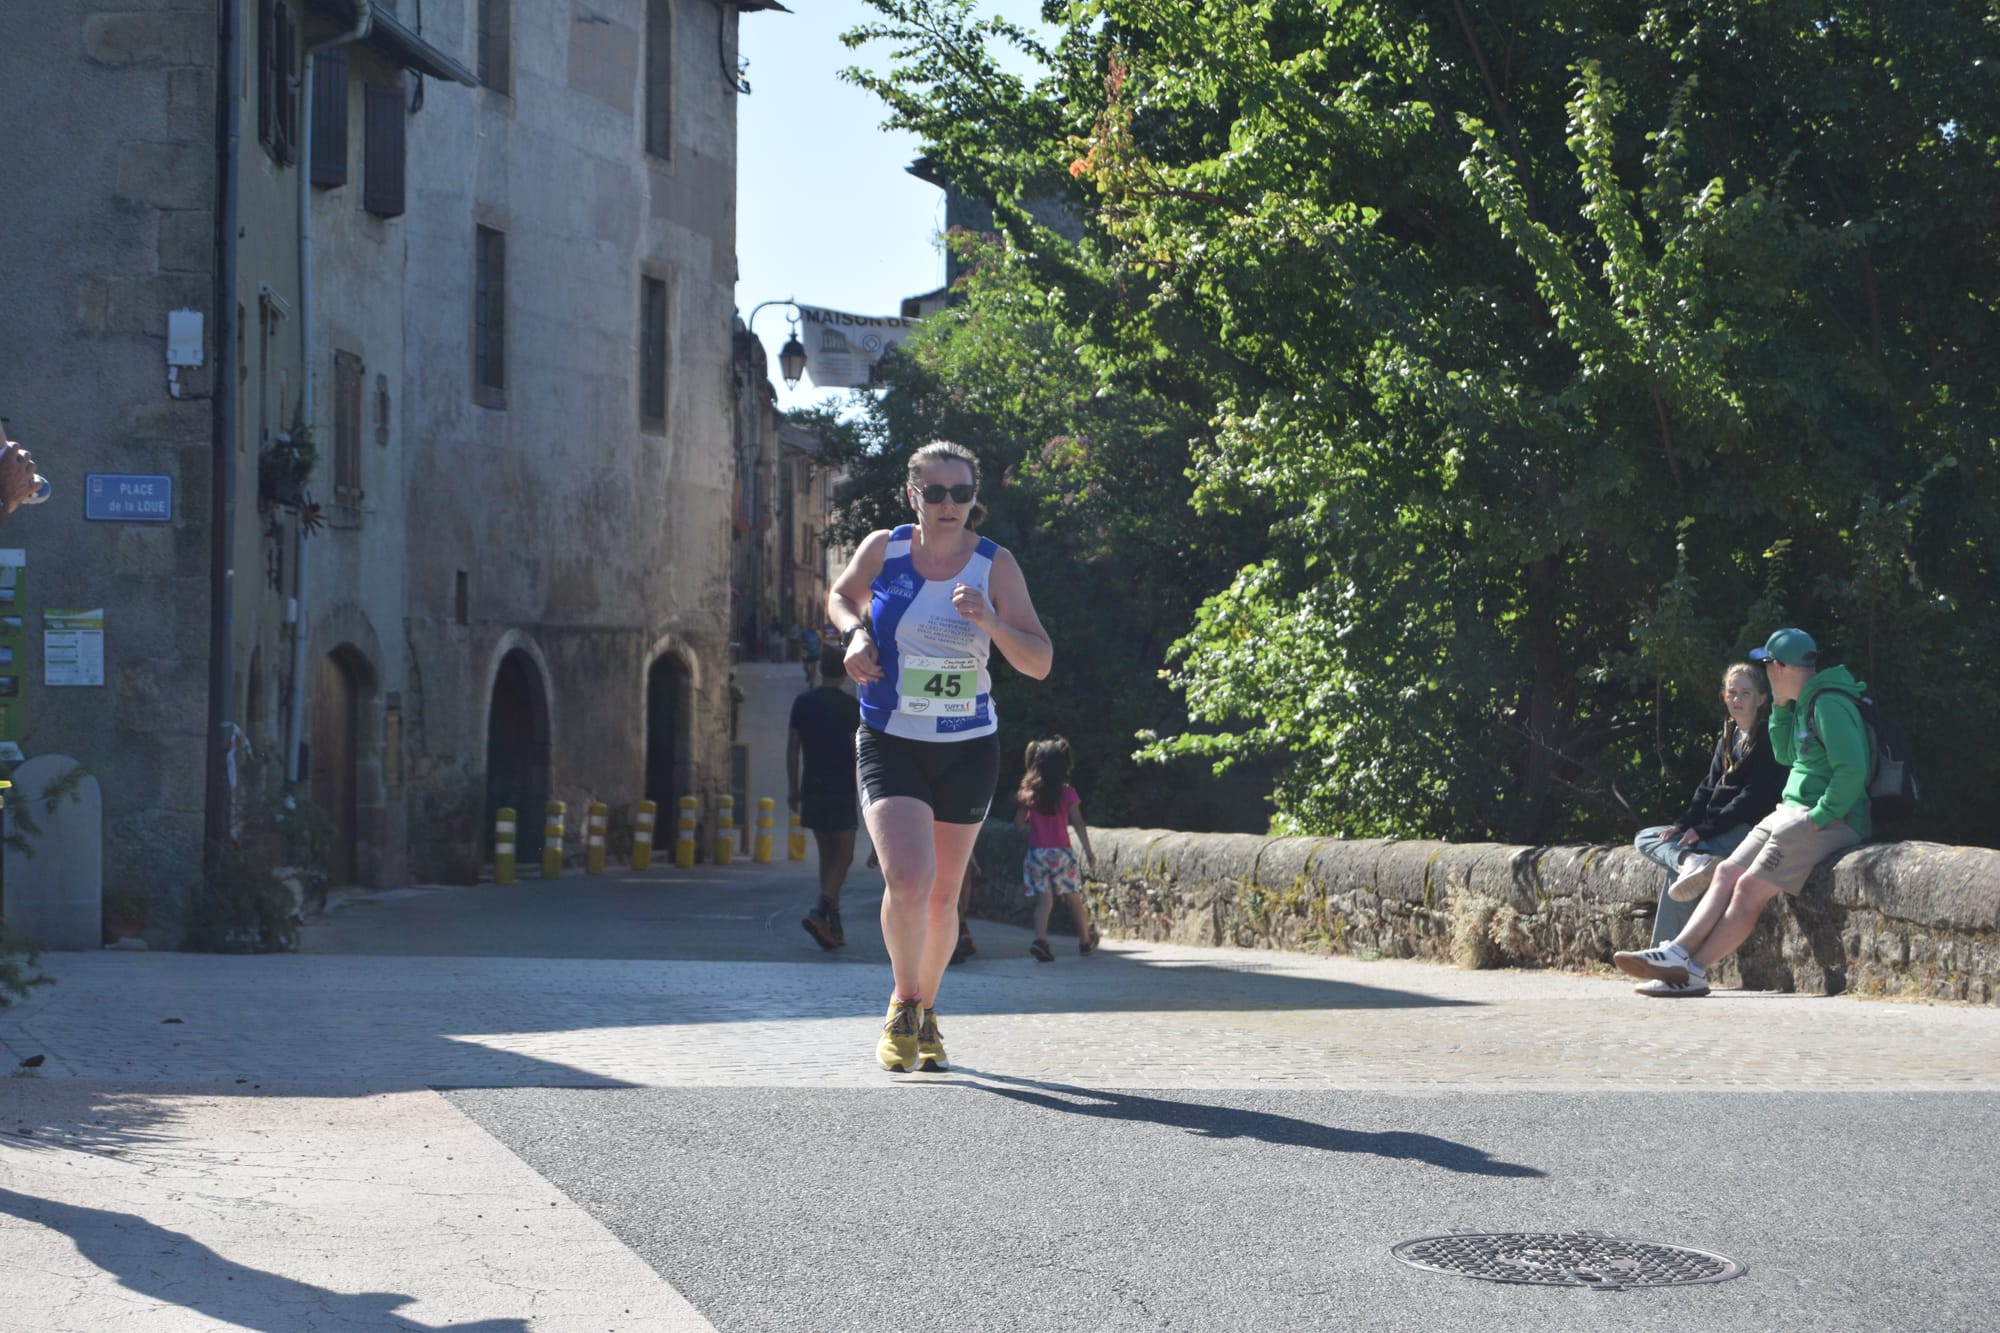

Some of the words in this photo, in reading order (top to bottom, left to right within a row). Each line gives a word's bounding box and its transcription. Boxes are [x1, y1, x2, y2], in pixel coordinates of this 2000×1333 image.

[805, 309, 882, 327] MAISON
[120, 483, 153, 496] PLACE
[109, 500, 121, 512] de
[125, 500, 134, 512] la
[137, 501, 165, 513] LOUE
[924, 673, 961, 697] 45
